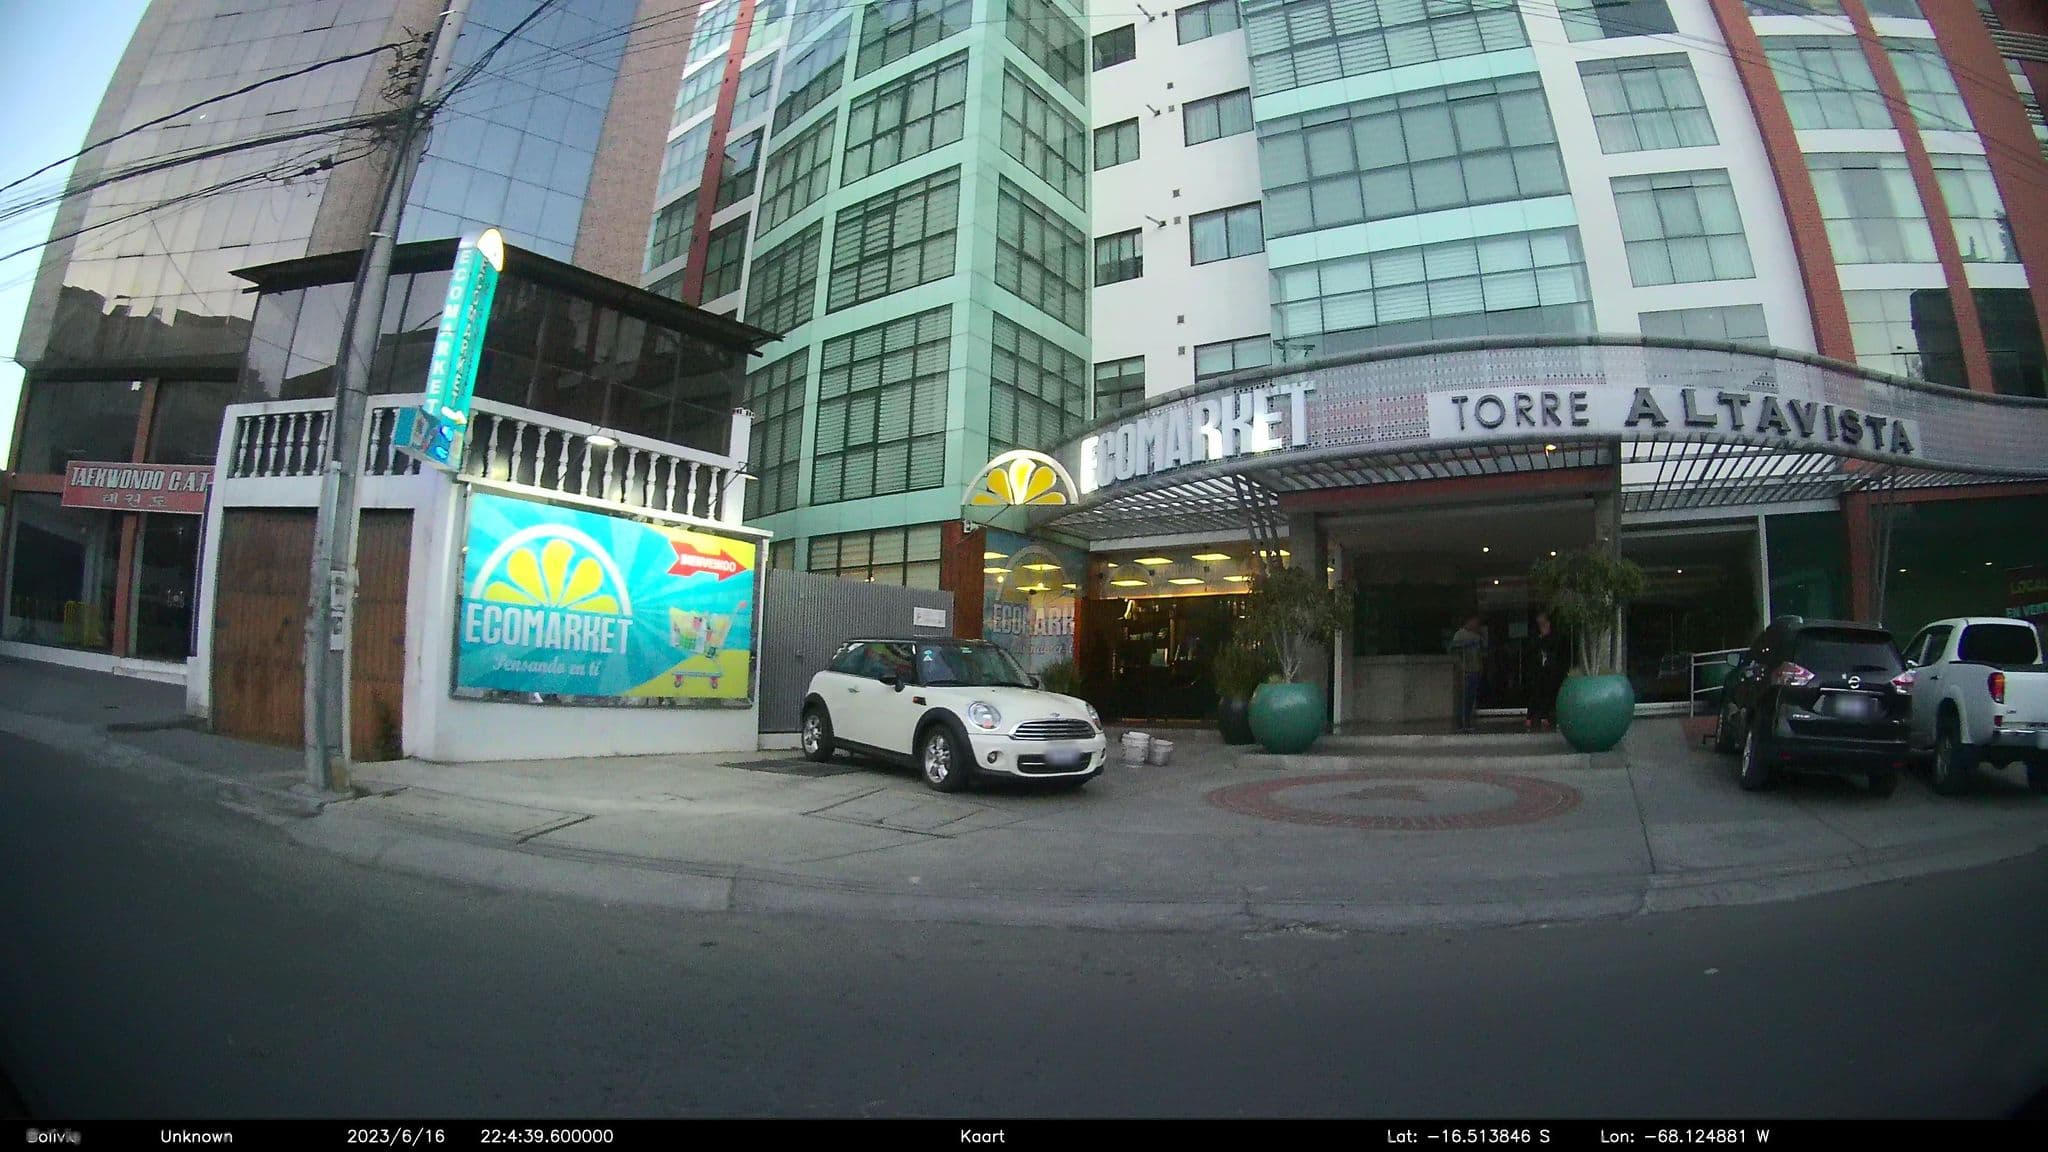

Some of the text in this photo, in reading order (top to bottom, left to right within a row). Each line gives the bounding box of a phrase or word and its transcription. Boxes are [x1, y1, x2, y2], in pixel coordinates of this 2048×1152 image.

[428, 251, 471, 412] ECOMARKET
[1080, 379, 1317, 494] ECOMARKET
[1452, 386, 1916, 455] TORRE ALTAVISTA
[71, 466, 165, 491] TAEKWONDO
[465, 603, 633, 656] ECOMARKET
[493, 654, 565, 675] Pensando
[568, 664, 586, 676] en
